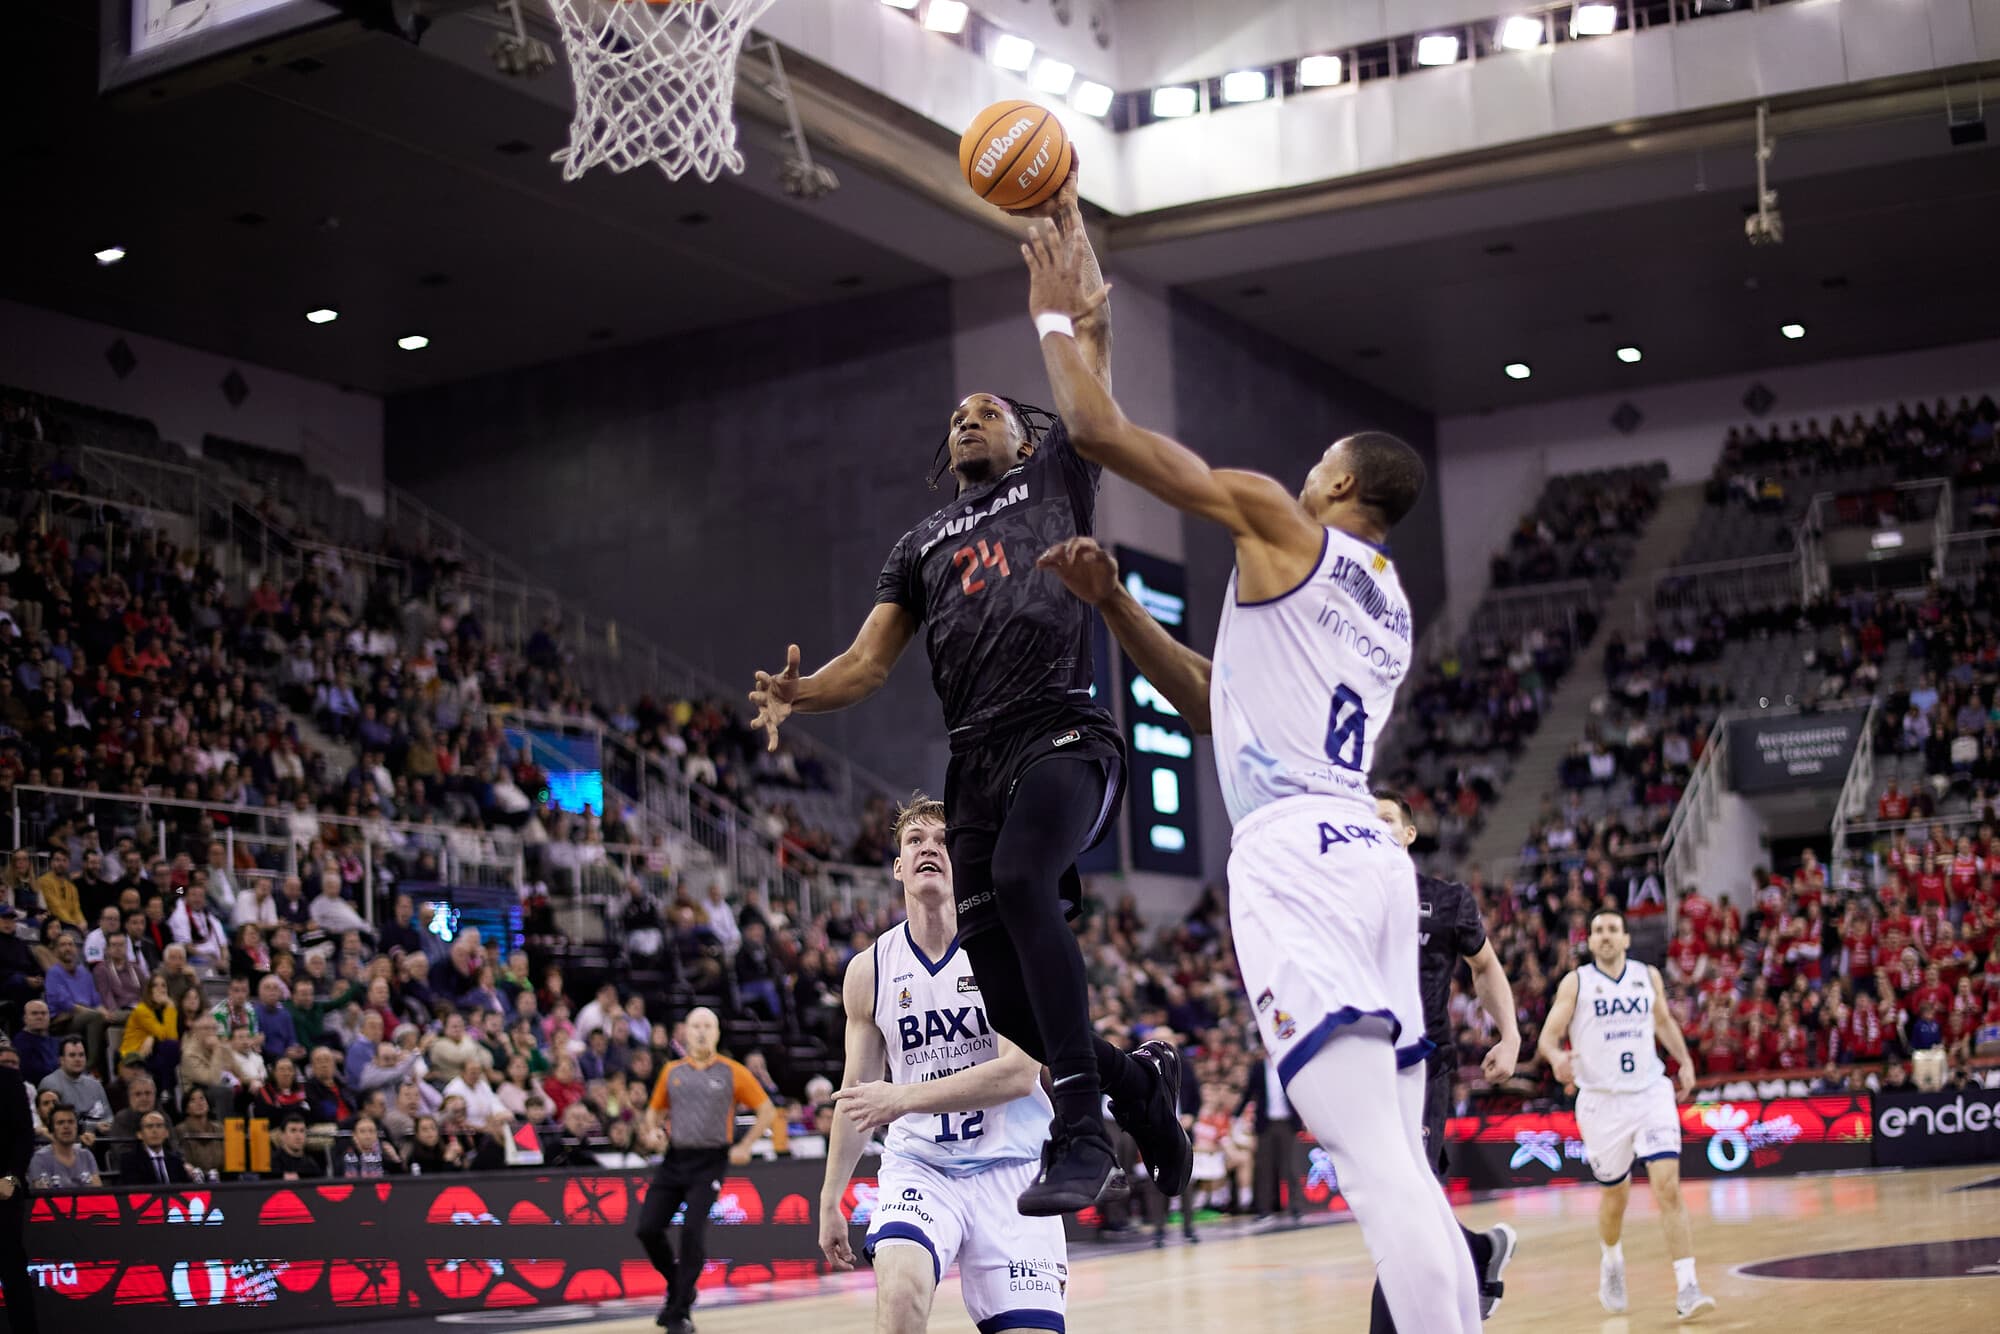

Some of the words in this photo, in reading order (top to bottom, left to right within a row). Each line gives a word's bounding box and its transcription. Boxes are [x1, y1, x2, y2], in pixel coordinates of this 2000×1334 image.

[975, 118, 1035, 178] Wilson
[954, 539, 1011, 596] 24
[1595, 997, 1649, 1017] BAXI
[897, 1006, 990, 1051] BAXI
[1620, 1052, 1635, 1073] 6
[933, 1110, 984, 1143] 12
[1009, 1279, 1057, 1294] GLOBAL
